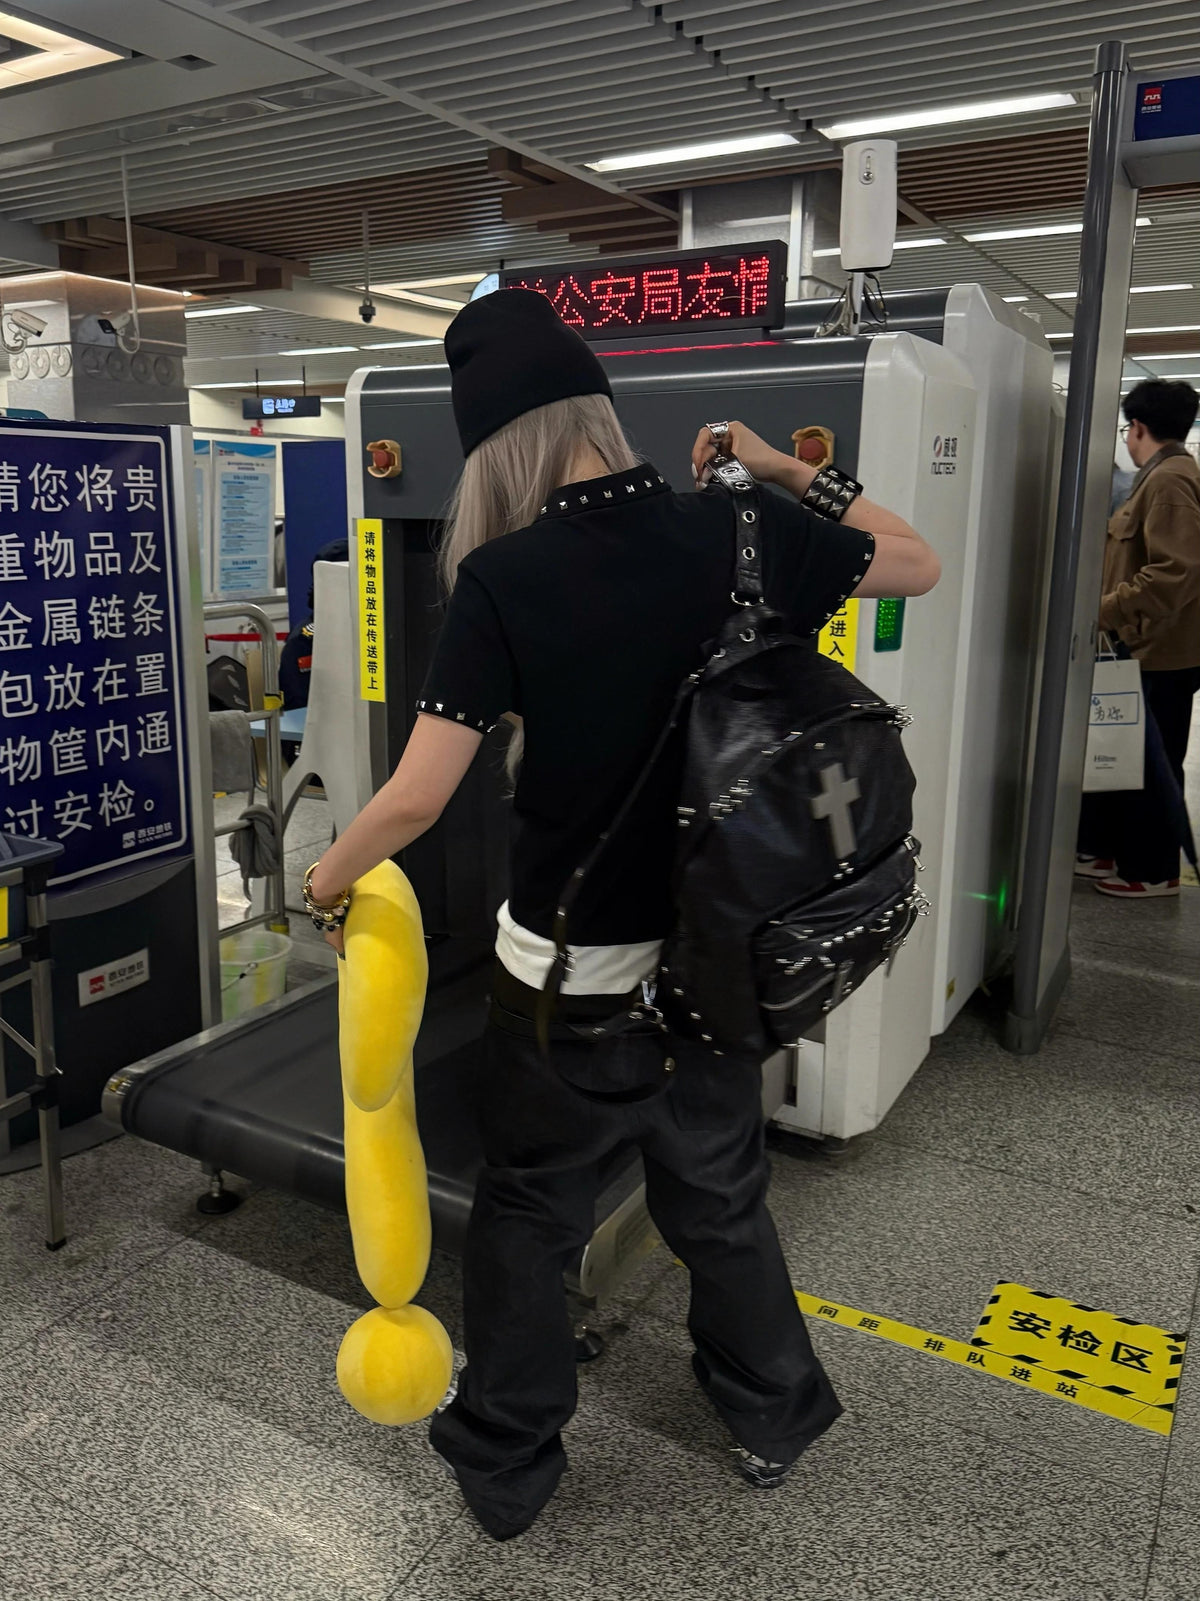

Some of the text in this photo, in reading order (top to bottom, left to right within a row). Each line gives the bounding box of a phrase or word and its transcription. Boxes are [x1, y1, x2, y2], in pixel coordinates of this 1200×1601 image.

[509, 256, 770, 327] 公安局友情
[0, 530, 161, 582] 重物品及
[0, 591, 164, 651] 金属链条
[364, 531, 378, 690] 请将物品放在传送带上
[828, 603, 847, 666] 进入
[0, 653, 169, 718] 包放在置
[0, 711, 172, 786] 物筐内通
[1007, 1309, 1154, 1374] 安检区
